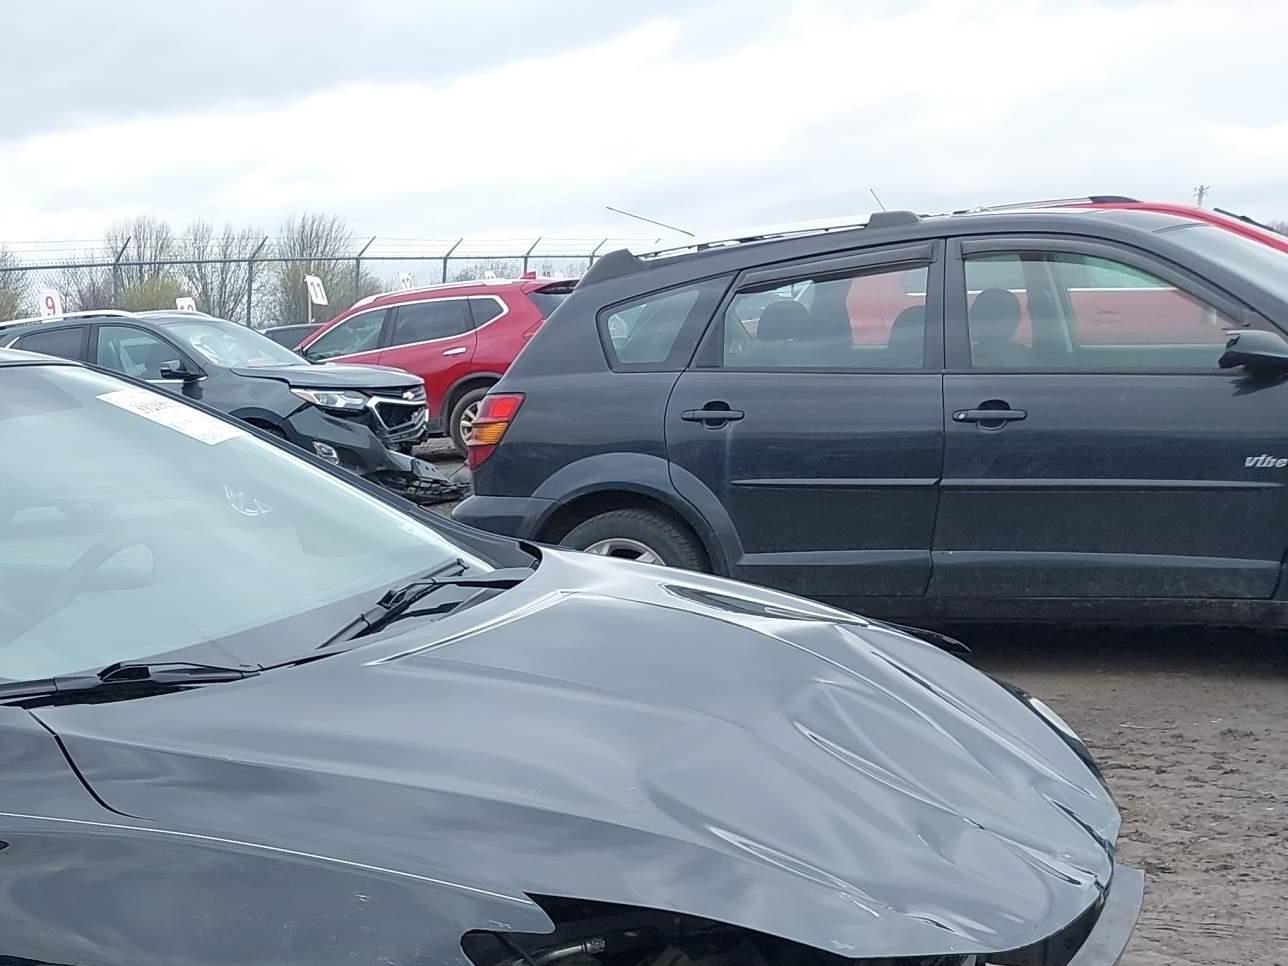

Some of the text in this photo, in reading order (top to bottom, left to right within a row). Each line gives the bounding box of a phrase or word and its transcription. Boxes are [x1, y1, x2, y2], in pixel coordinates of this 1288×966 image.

[310, 281, 325, 300] 11
[45, 295, 56, 316] 9
[1244, 454, 1288, 468] vibe
